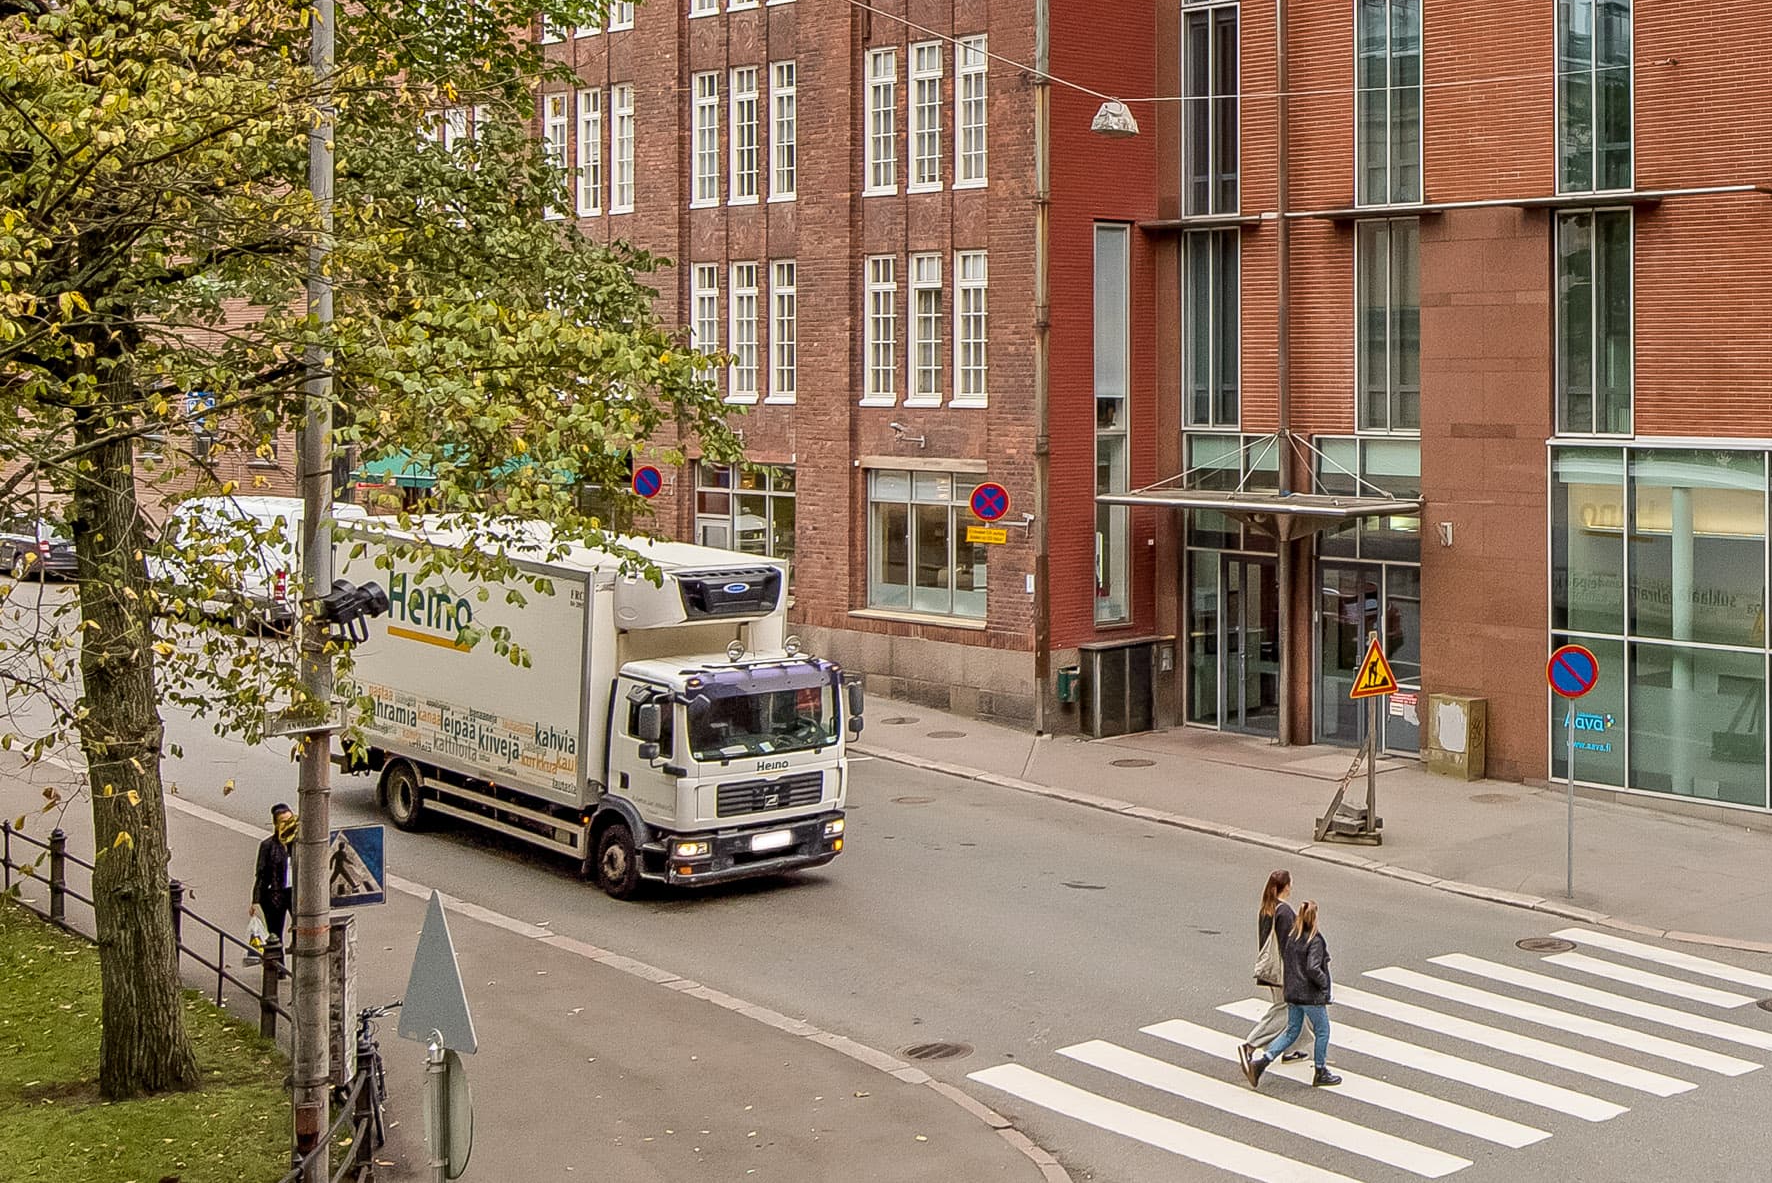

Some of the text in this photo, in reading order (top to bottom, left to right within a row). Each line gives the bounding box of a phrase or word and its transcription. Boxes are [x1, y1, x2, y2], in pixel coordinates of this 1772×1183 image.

[478, 724, 520, 765] kiivejä
[535, 721, 576, 755] kahvia
[756, 760, 789, 772] Heino
